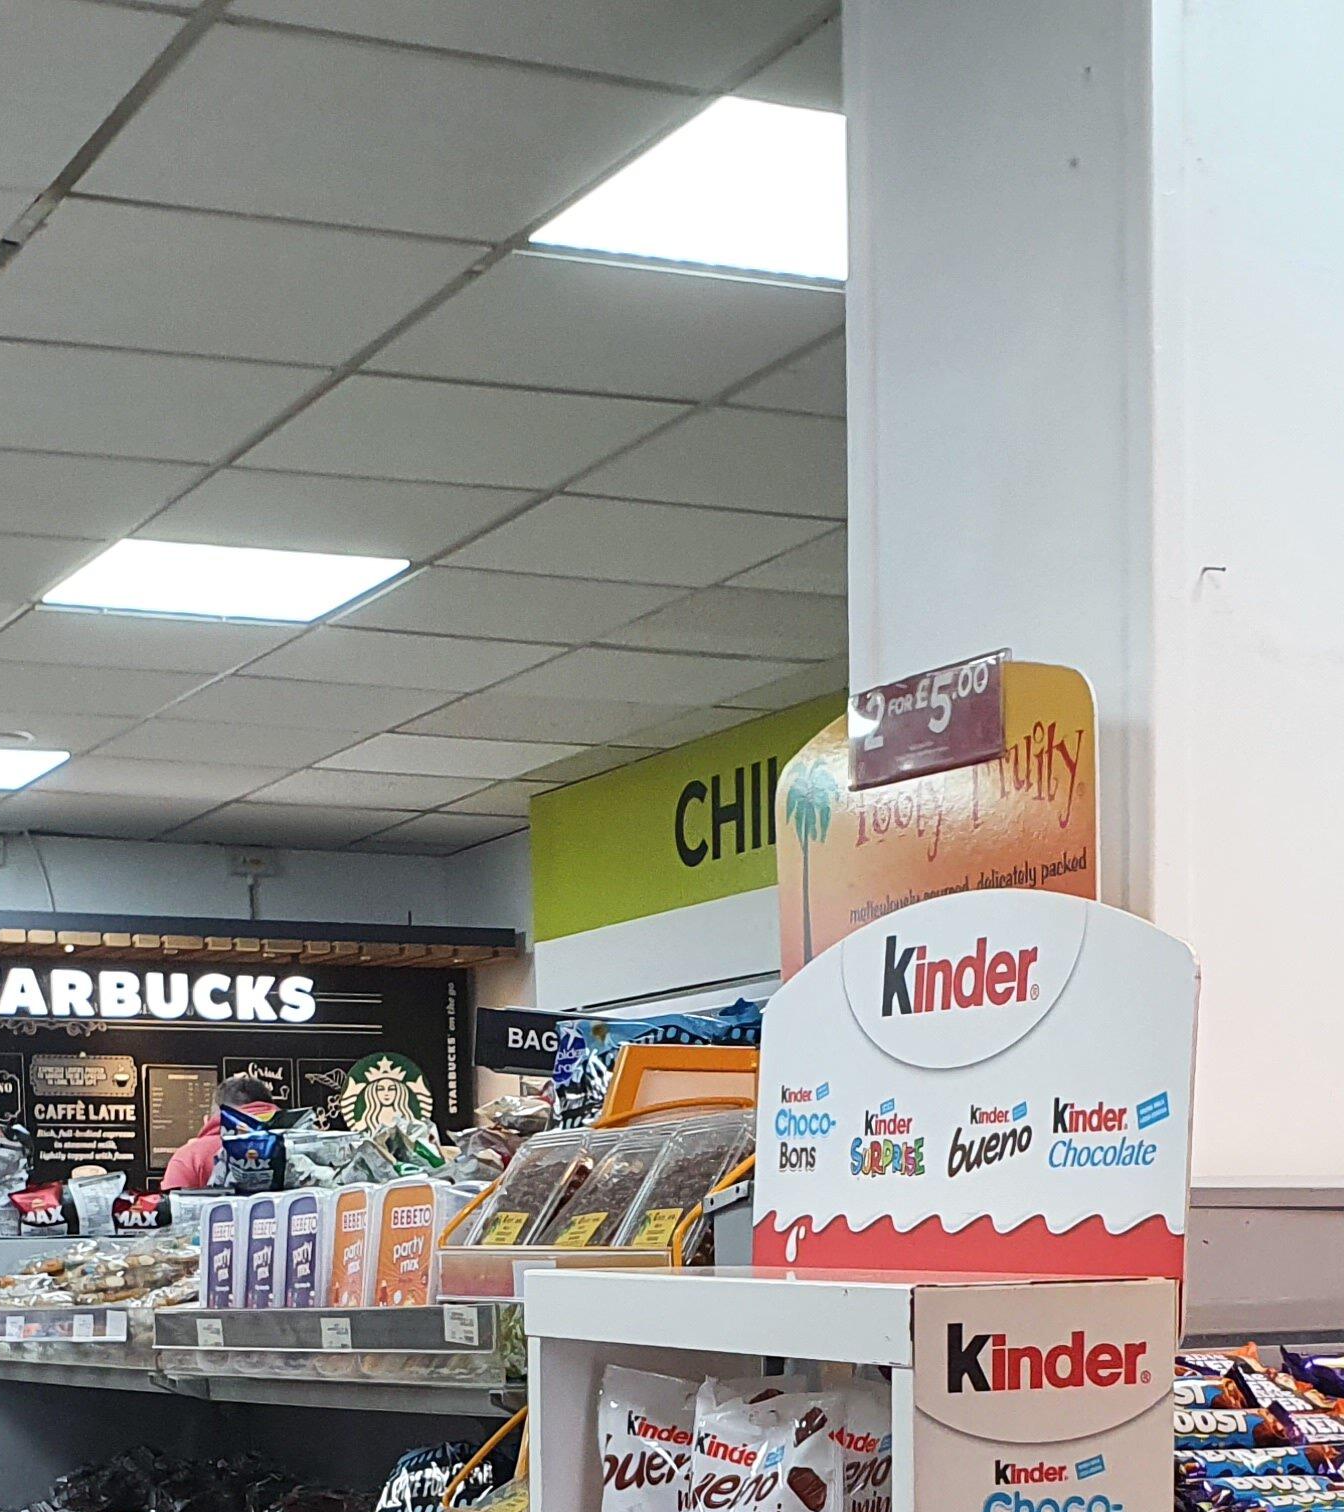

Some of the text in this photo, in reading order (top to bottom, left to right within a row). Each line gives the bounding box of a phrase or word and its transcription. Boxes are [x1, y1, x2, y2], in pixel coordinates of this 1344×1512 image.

[888, 694, 913, 717] FOR
[915, 663, 989, 734] £5.00
[977, 846, 1087, 890] delicately packed
[248, 1062, 284, 1080] Grind
[448, 1035, 457, 1114] STARBUCKS
[34, 1100, 137, 1121] CAFFÈ LATTE
[775, 1108, 836, 1137] Choco-
[779, 1141, 816, 1173] Bons
[947, 1125, 1032, 1179] bueno
[1048, 1137, 1156, 1169] Chocolate
[392, 1207, 432, 1227] BEBETO
[393, 1235, 424, 1263] party
[399, 1258, 419, 1274] mix
